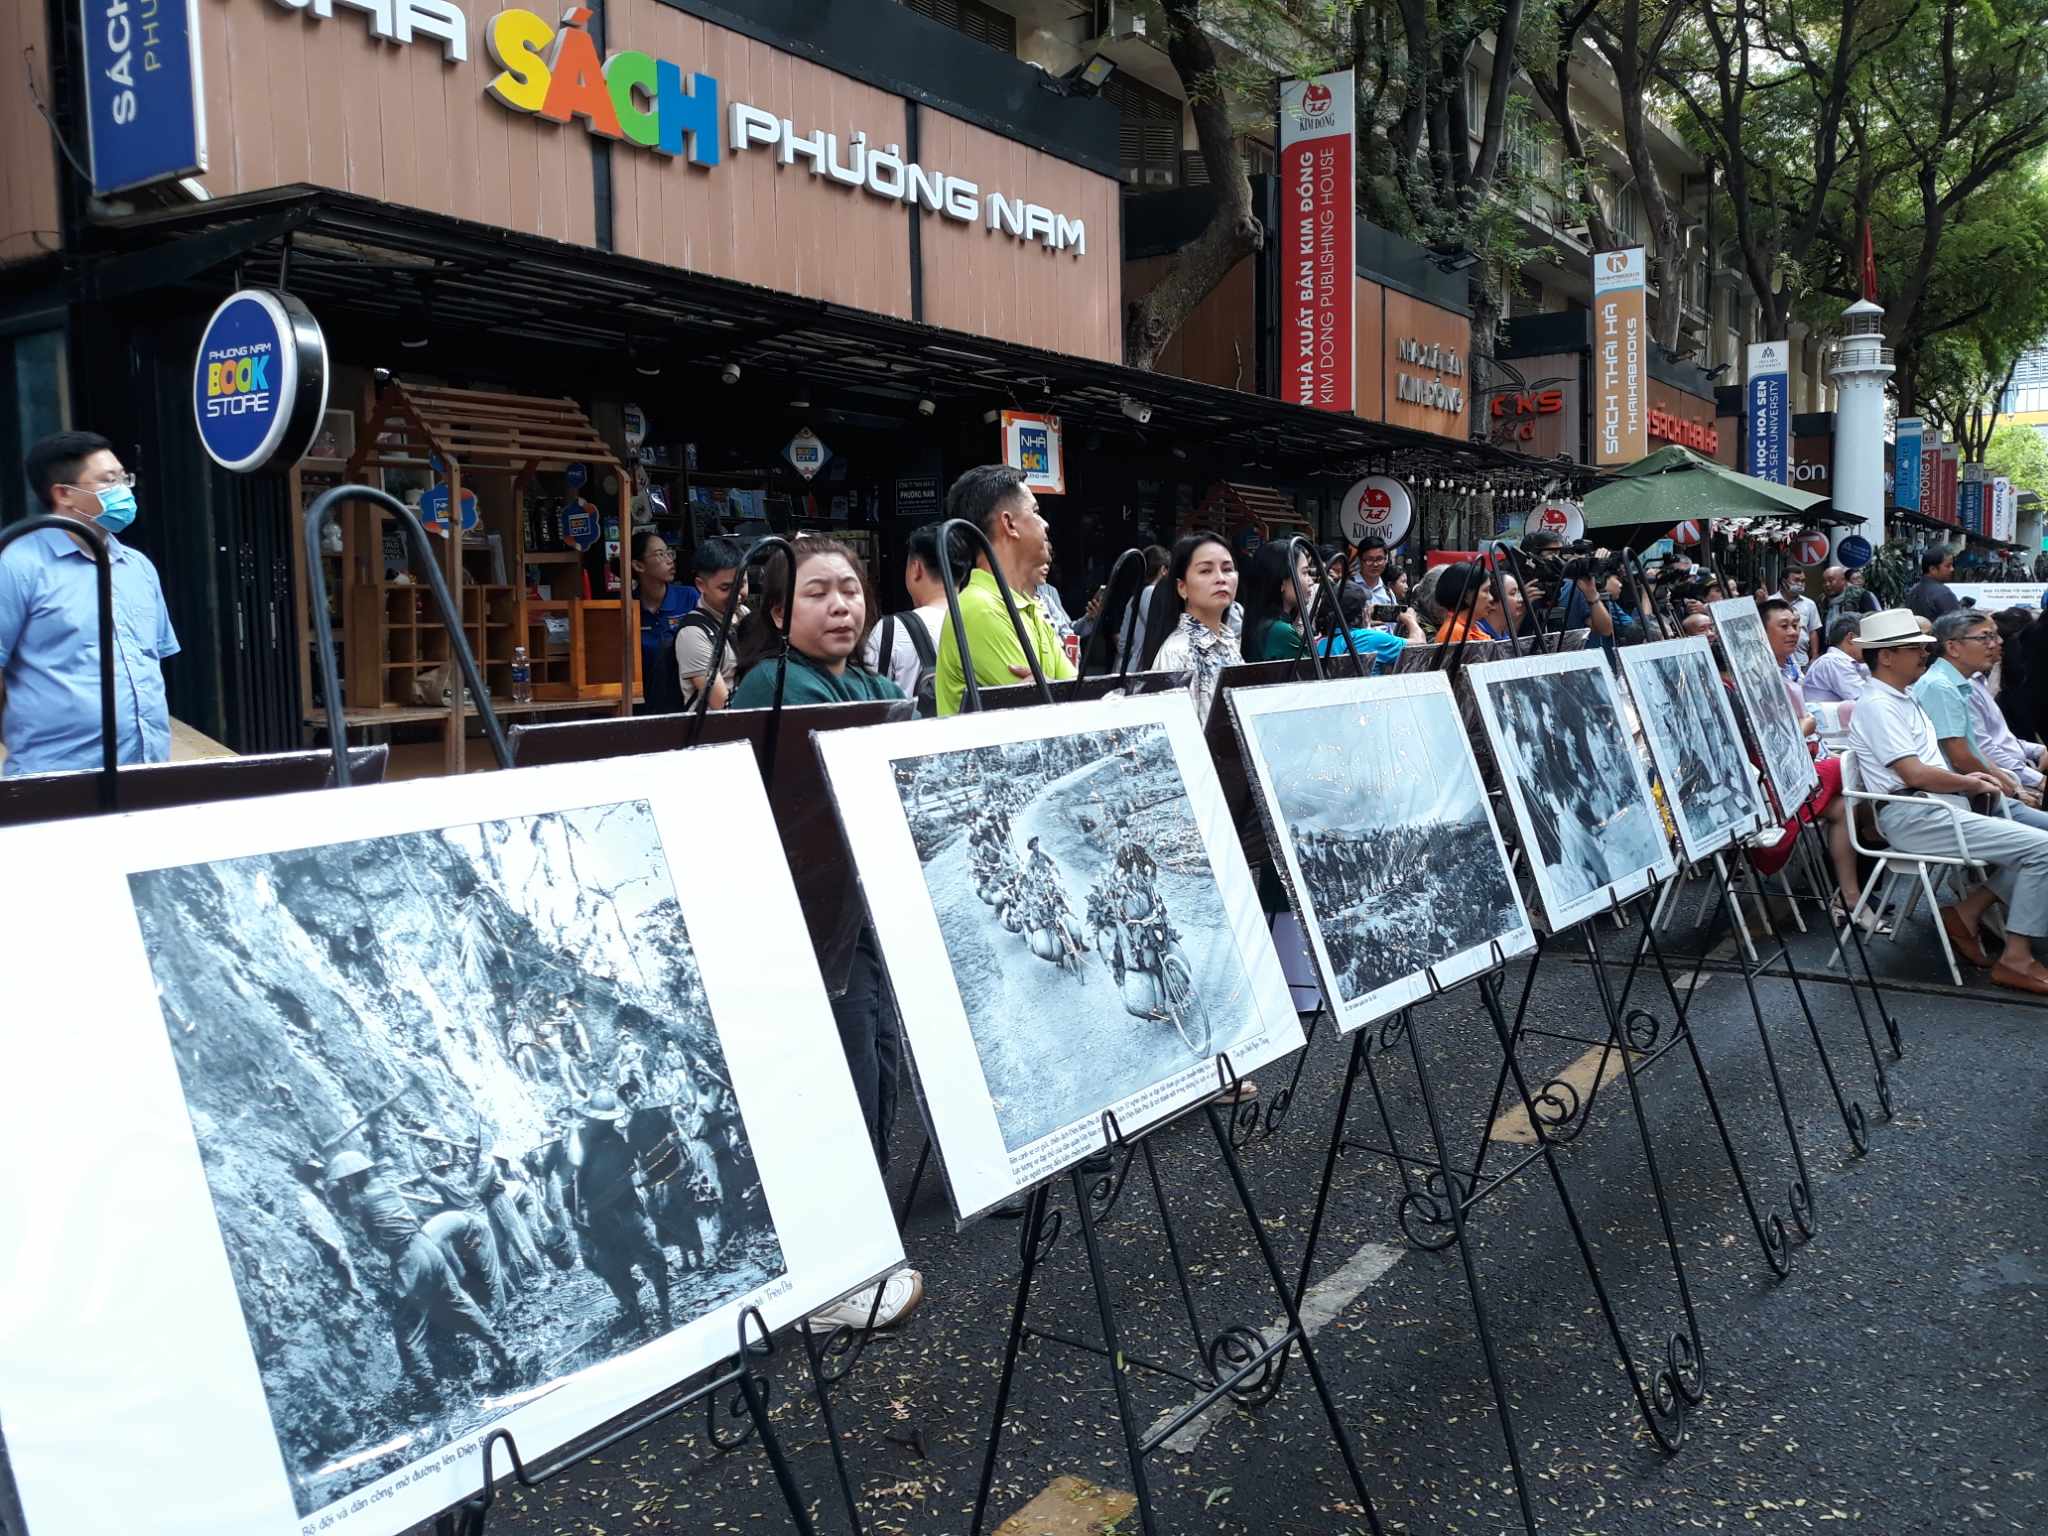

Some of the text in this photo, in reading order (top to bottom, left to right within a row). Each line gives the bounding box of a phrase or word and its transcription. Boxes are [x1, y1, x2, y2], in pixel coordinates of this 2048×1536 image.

[485, 6, 720, 168] SÁCH
[729, 102, 980, 222] PHƯƠNG
[985, 191, 1086, 257] NAM
[1296, 152, 1314, 406] NHÀ XUẤT BẢN KIM ĐỒNG
[1320, 147, 1335, 404] KIM DONG PUBLISHING HOUSE
[207, 354, 270, 397] BOOK
[1602, 341, 1619, 389] THÁI
[206, 392, 270, 418] STORE
[1757, 380, 1768, 405] SEN
[1769, 380, 1780, 443] UNIVERSITY
[1602, 396, 1620, 454] SÁCH
[1757, 408, 1768, 437] HOA
[370, 1484, 394, 1505] công
